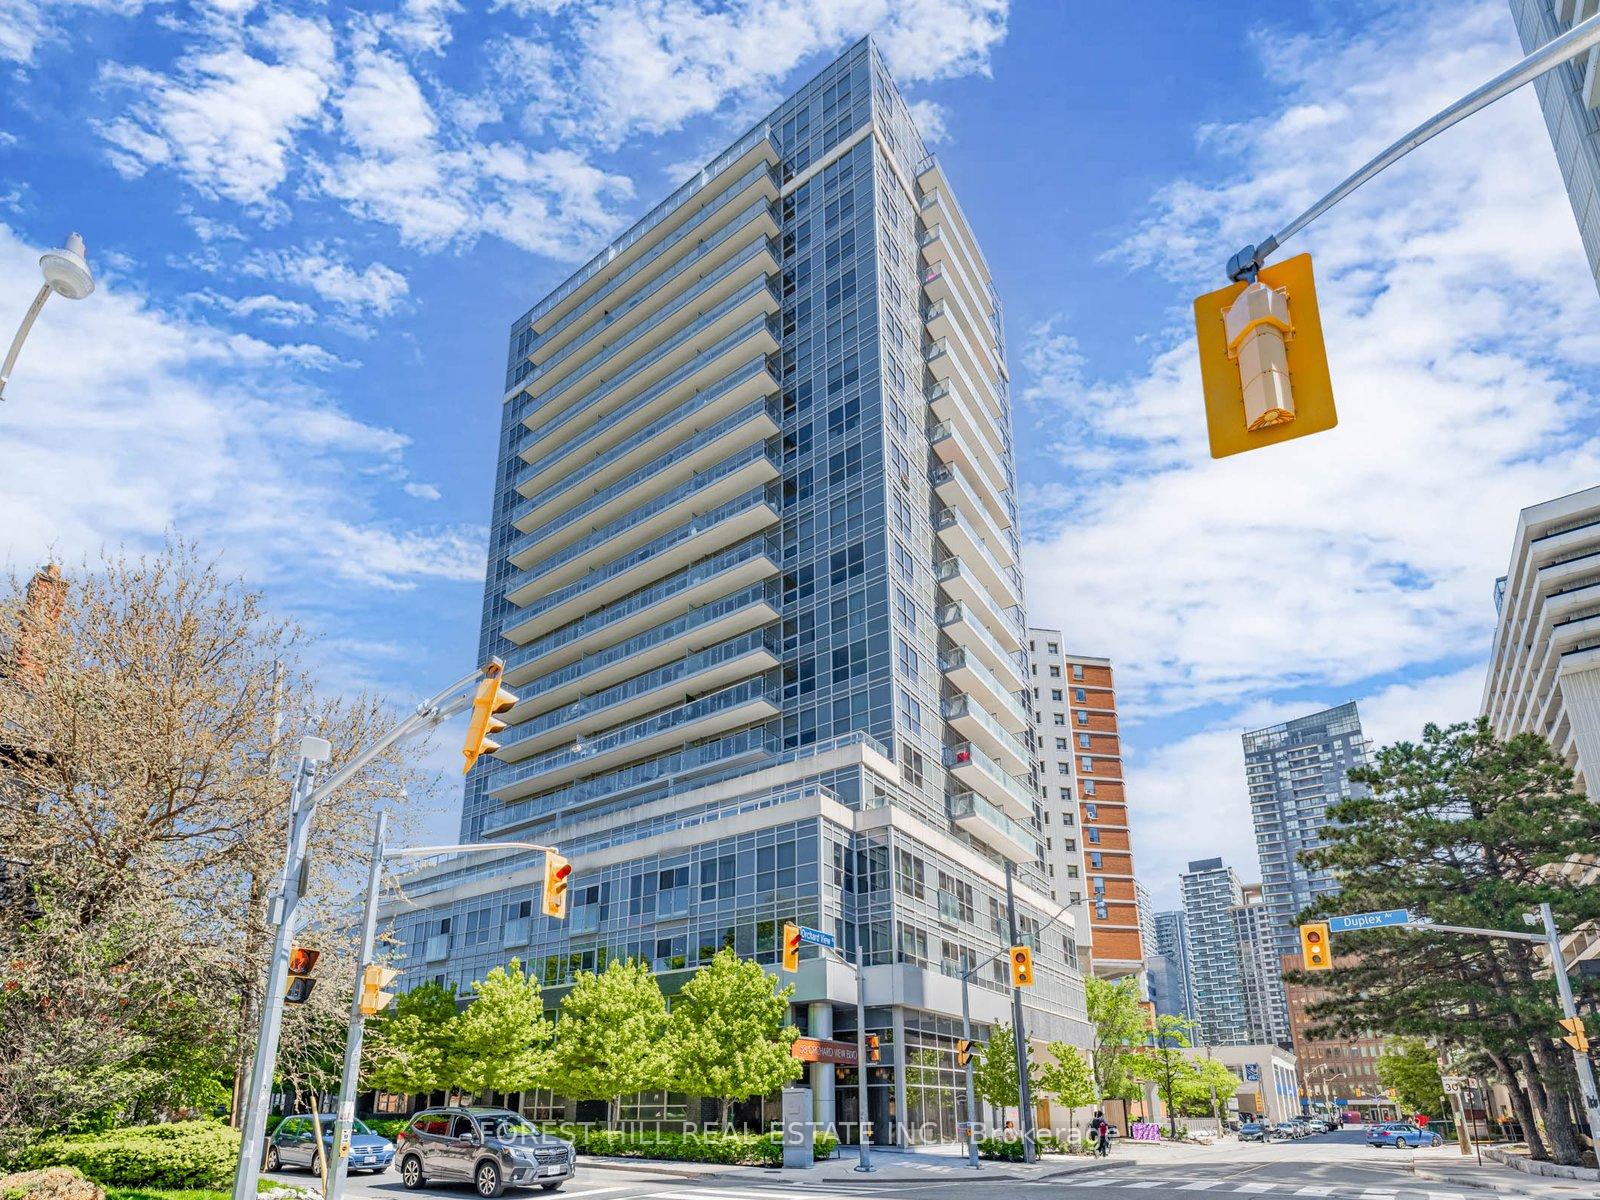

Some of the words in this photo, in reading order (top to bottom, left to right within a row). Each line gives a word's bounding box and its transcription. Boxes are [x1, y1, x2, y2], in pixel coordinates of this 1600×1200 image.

[1343, 914, 1382, 928] Duplex
[800, 928, 820, 943] Orchard
[820, 934, 831, 946] View
[809, 1045, 833, 1057] ORCHARD
[1445, 1083, 1459, 1092] 30
